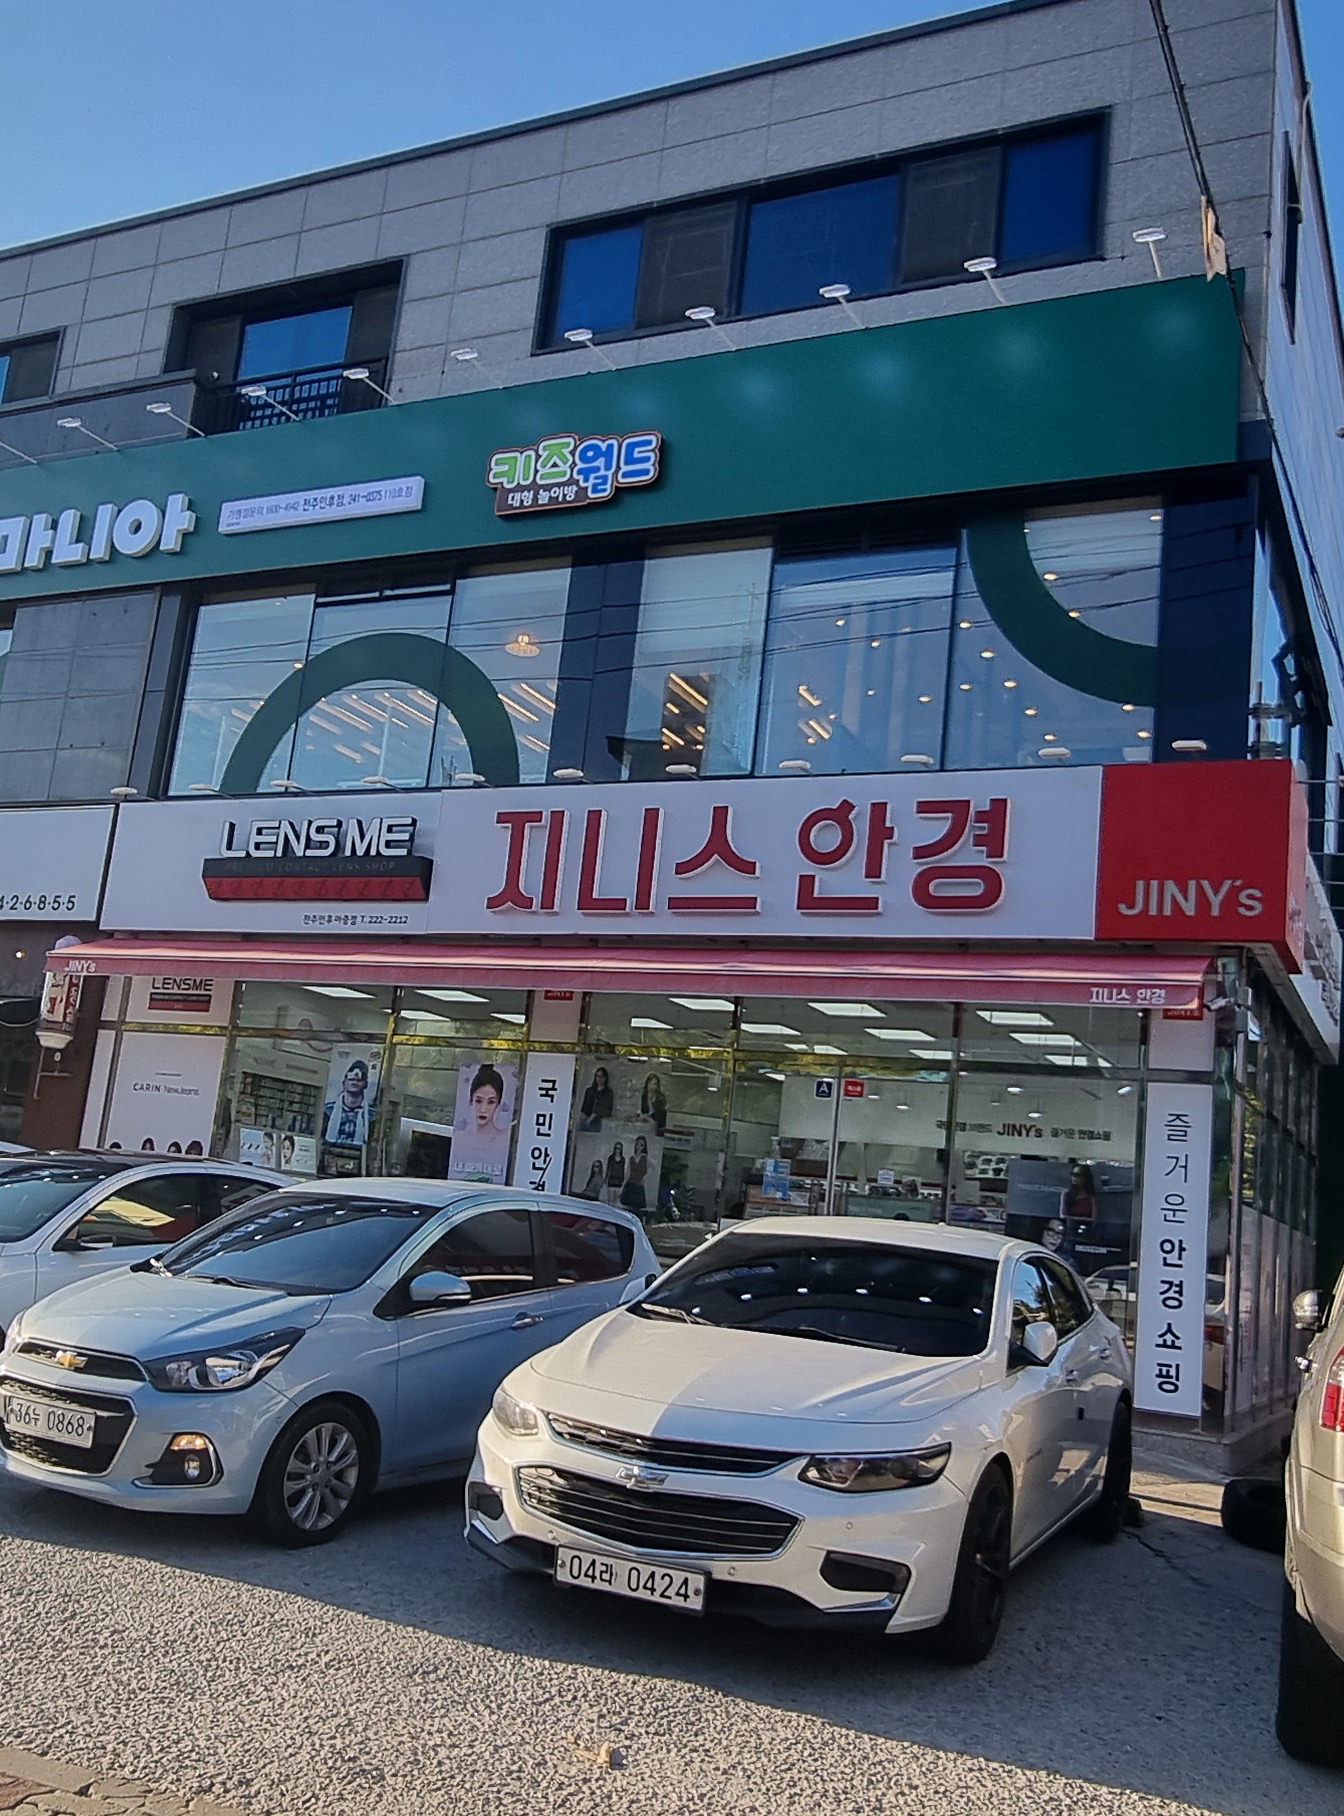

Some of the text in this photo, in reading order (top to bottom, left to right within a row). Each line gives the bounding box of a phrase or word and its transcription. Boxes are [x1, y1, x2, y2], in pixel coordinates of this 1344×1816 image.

[491, 438, 656, 496] 키즈월드
[507, 486, 578, 507] 대형 놀이방
[485, 796, 1012, 914] 지니스 안경
[151, 977, 214, 992] LENSME
[1089, 986, 1167, 1005] 지니스 안경
[133, 1082, 161, 1093] CARIN
[47, 1408, 85, 1437] 0868
[569, 1554, 691, 1603] 04라 0424
